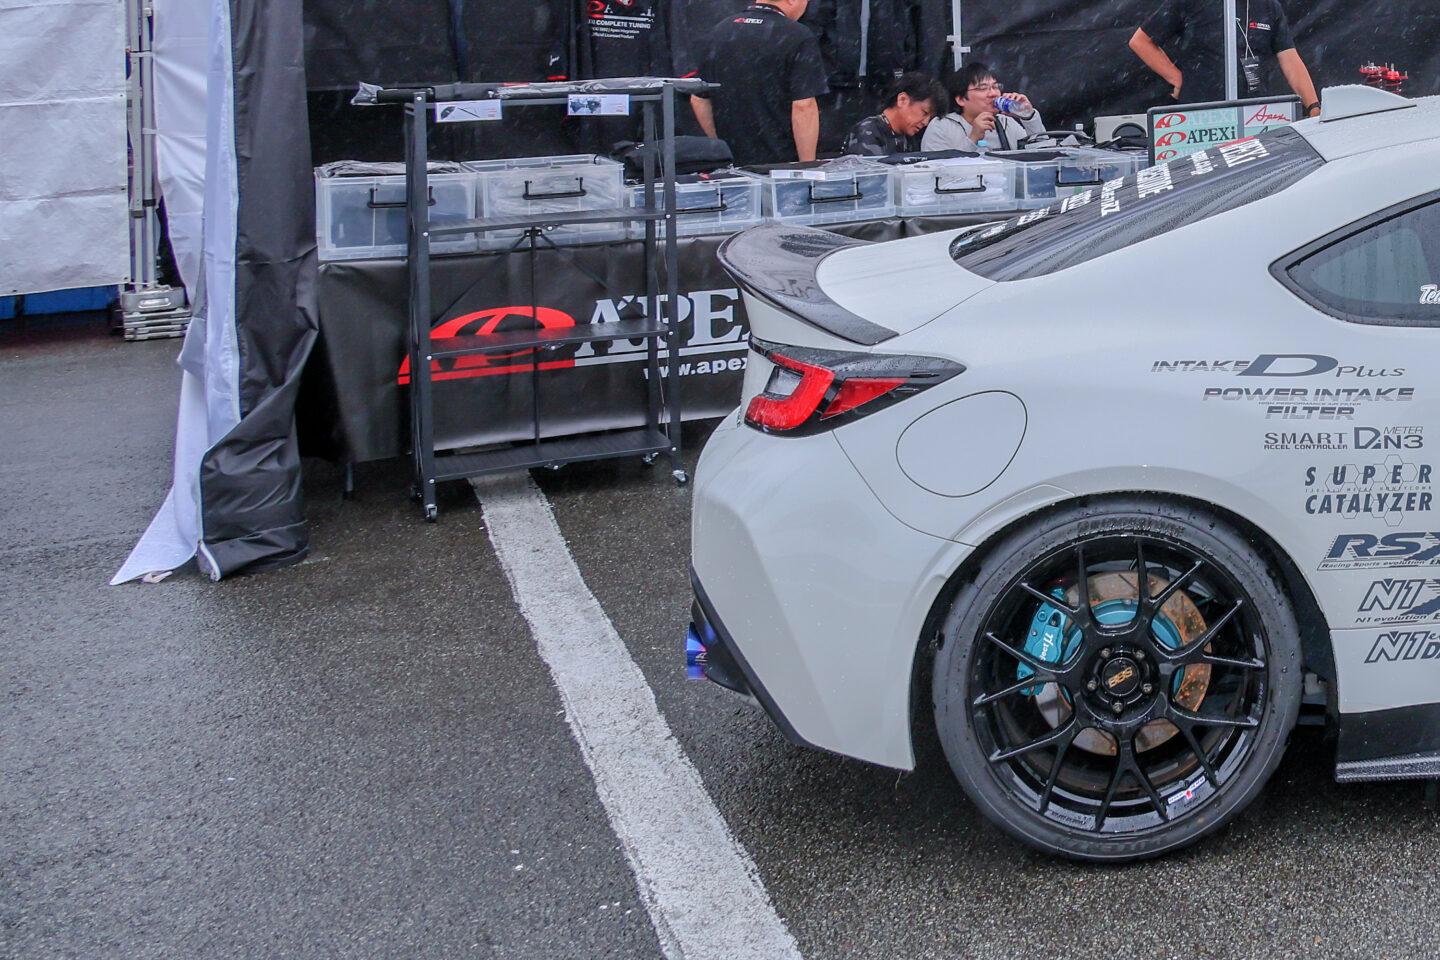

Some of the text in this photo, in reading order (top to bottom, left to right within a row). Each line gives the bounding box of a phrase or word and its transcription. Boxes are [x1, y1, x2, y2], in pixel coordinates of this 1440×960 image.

[1150, 360, 1251, 372] INTAKE
[1335, 365, 1406, 378] Plus
[1202, 387, 1415, 402] POWER INTAKE
[1265, 406, 1355, 420] FILTER
[1264, 432, 1348, 444] SMART
[1383, 426, 1424, 435] METER
[1304, 464, 1432, 486] SUPER
[1305, 492, 1433, 514] CATALYZER
[1107, 666, 1134, 688] BBS
